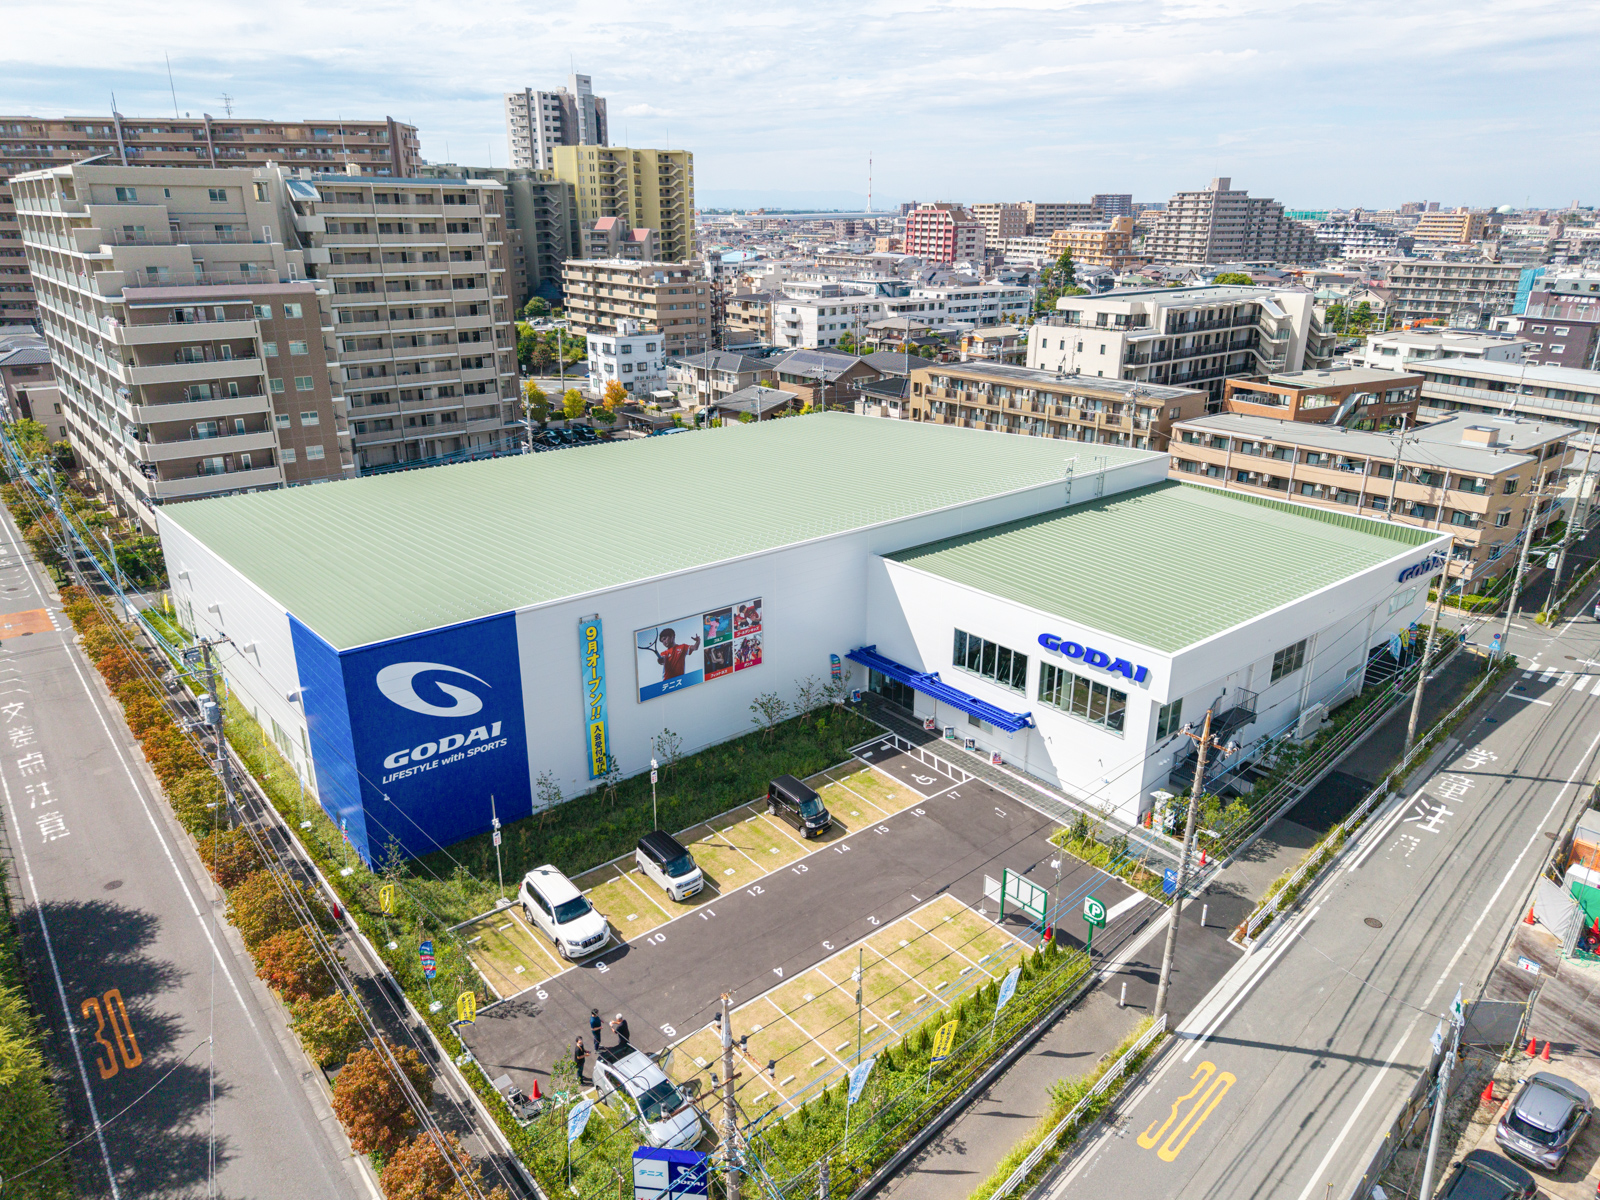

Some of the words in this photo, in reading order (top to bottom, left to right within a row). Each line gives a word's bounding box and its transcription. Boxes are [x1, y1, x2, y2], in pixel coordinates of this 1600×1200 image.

[1037, 633, 1149, 683] GODAI
[586, 626, 603, 721] 9月オープン!!
[661, 679, 682, 692] テニス
[383, 721, 502, 769] GODAI
[382, 759, 439, 784] LIFESTYLE
[441, 752, 465, 765] with
[467, 738, 508, 757] SPORTS
[1, 702, 70, 843] 交差点注意
[947, 791, 961, 800] 17
[911, 808, 926, 817] 16
[873, 825, 890, 835] 15
[834, 843, 851, 854] 14
[791, 864, 809, 875] 13
[747, 885, 765, 897] 12
[699, 909, 716, 920] 11
[1091, 904, 1101, 916] P
[867, 915, 880, 925] 2
[647, 933, 666, 945] 10
[822, 940, 835, 950] 3
[772, 967, 783, 977] 4
[536, 989, 549, 1000] 8
[81, 988, 143, 1080] 30
[1137, 1061, 1237, 1163] 30
[639, 1169, 664, 1177] テニス
